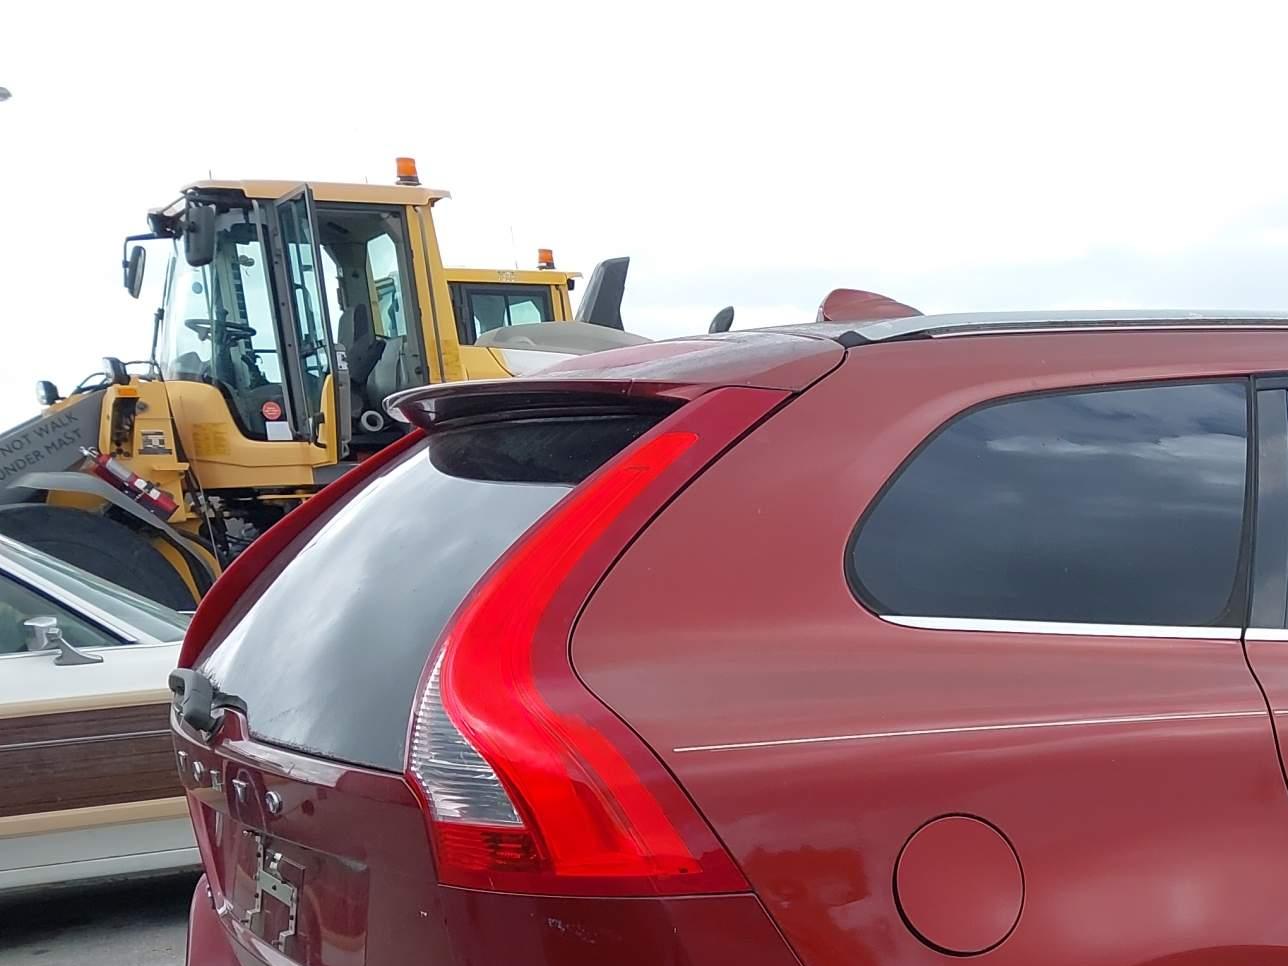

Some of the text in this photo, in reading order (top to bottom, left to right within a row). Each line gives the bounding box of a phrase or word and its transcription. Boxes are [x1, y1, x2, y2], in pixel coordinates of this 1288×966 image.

[0, 411, 79, 456] NOT WALK
[44, 428, 81, 454] MAST
